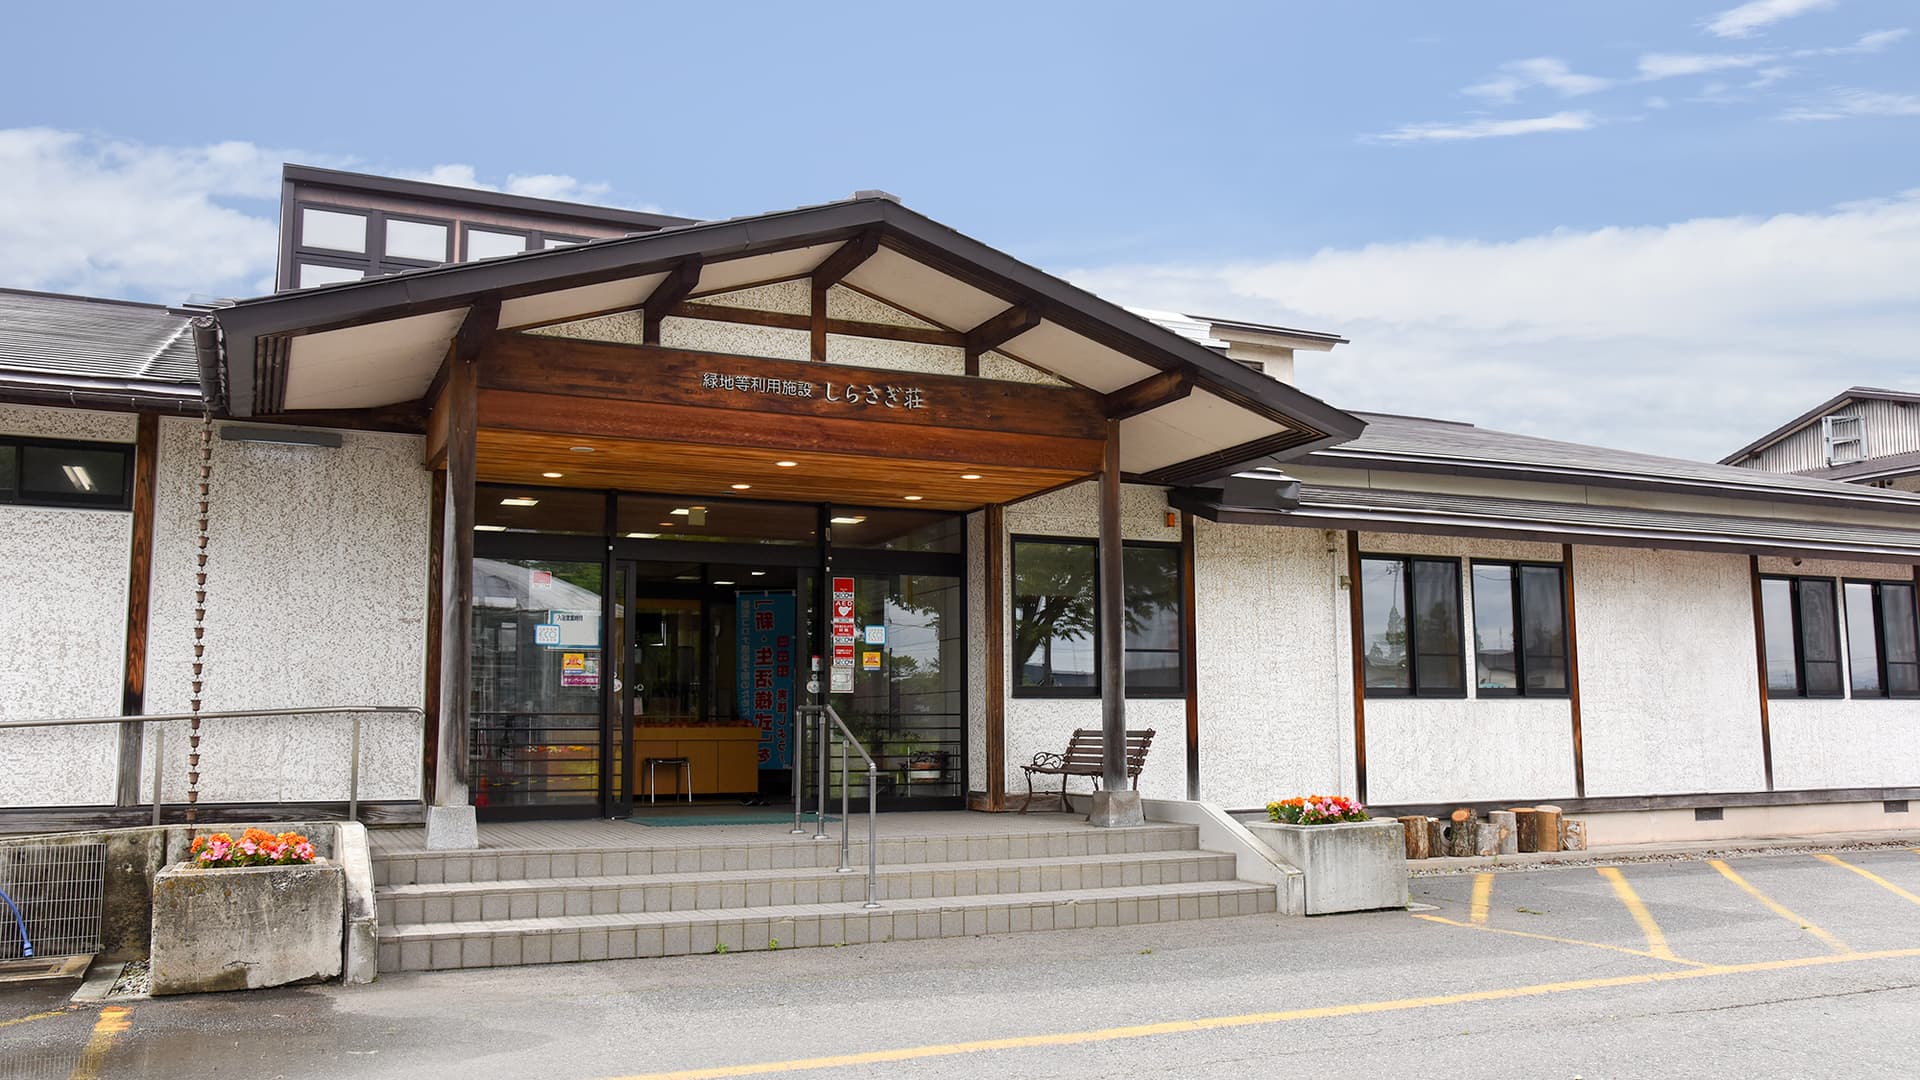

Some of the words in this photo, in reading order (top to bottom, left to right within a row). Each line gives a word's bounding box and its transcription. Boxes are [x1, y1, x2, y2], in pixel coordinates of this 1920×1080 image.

[702, 372, 812, 398] 緑地等利用施設
[825, 382, 924, 410] しらさぎ荘
